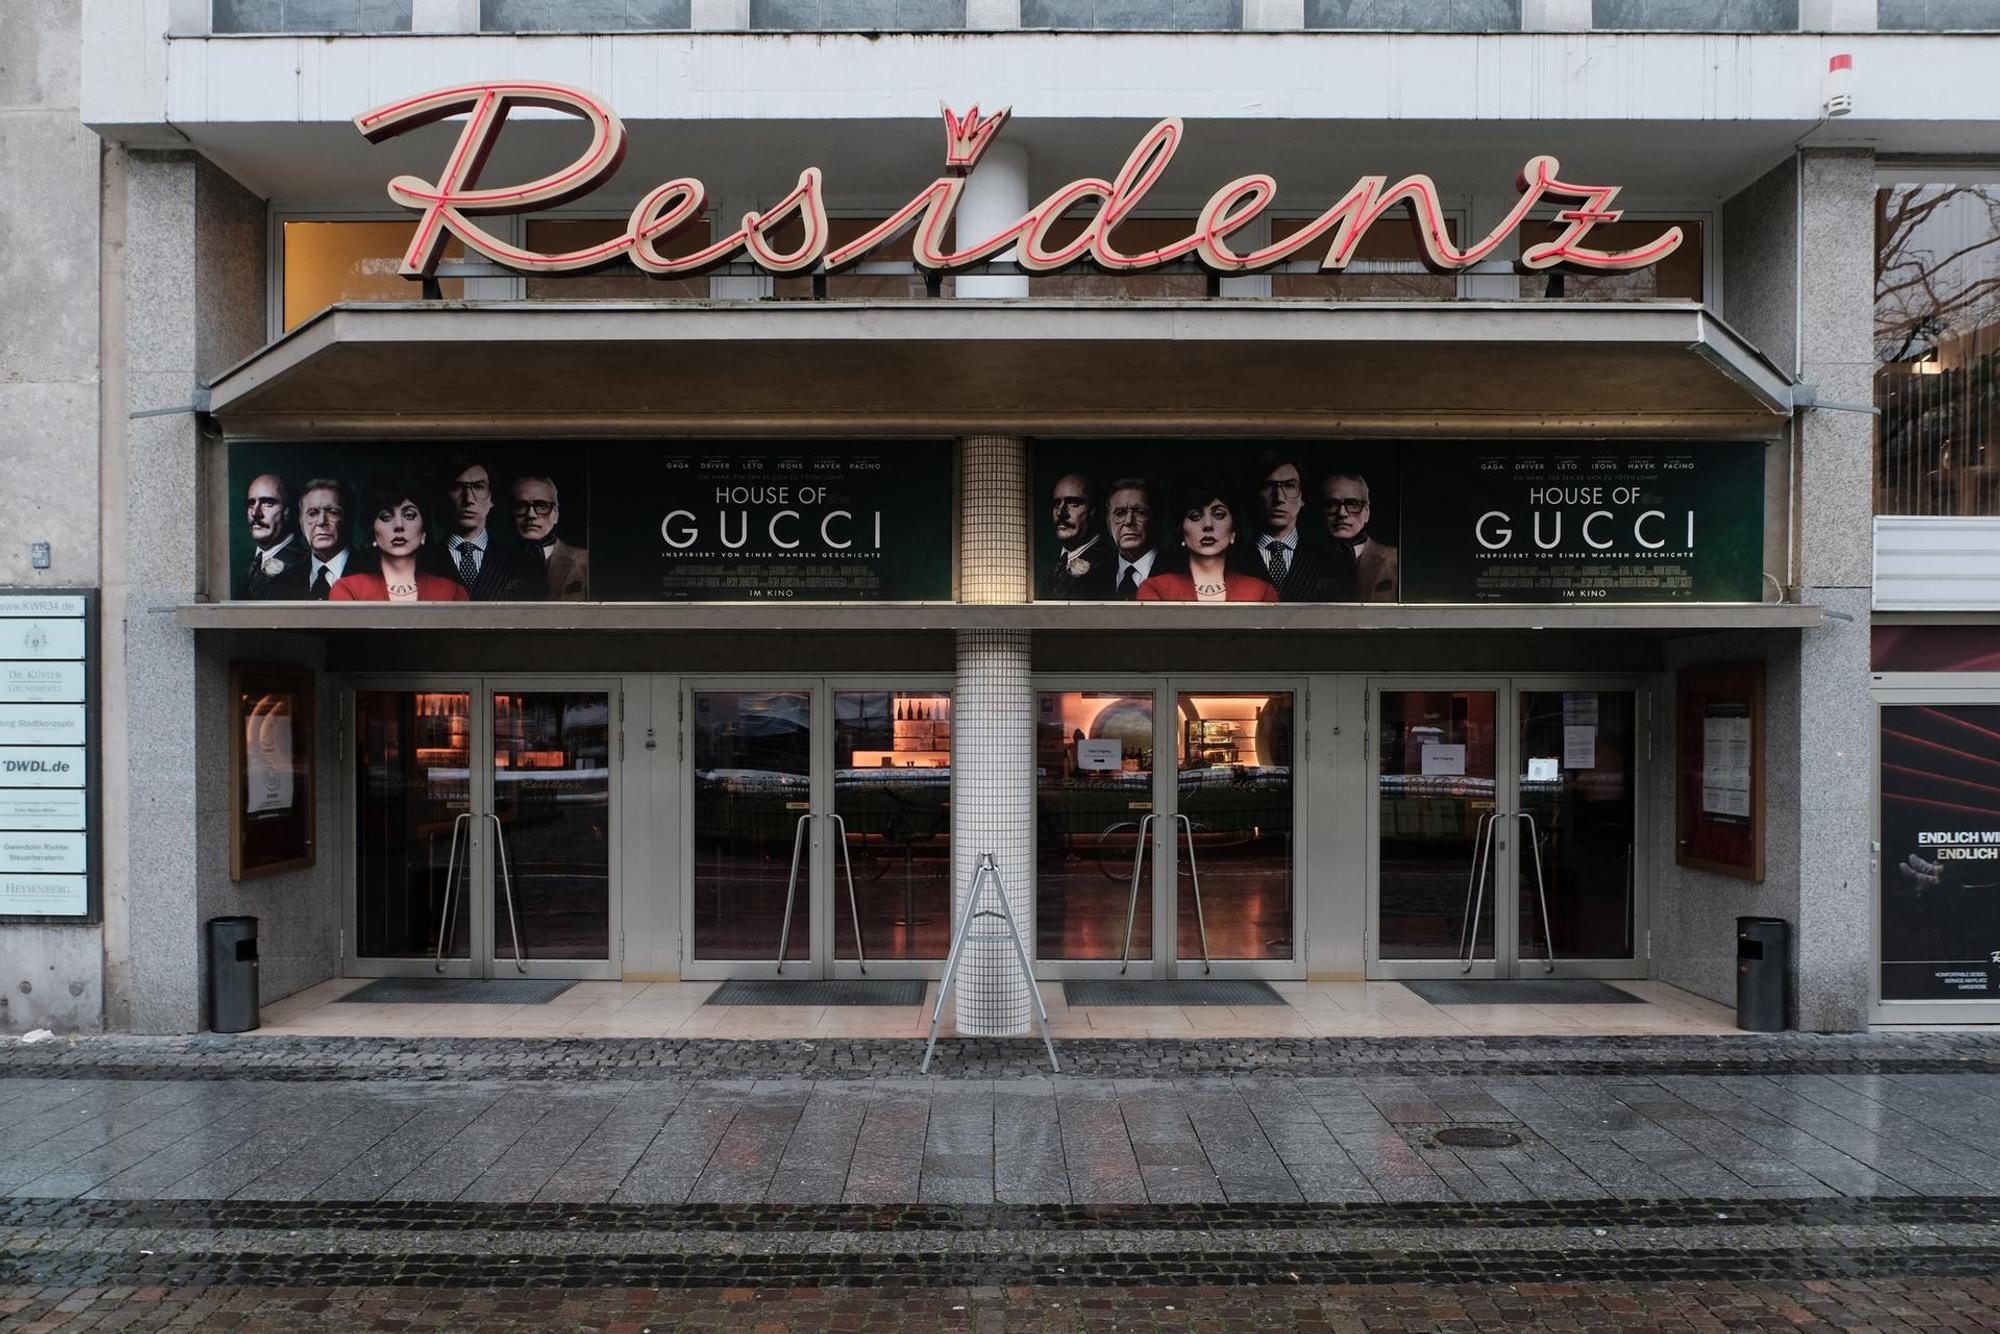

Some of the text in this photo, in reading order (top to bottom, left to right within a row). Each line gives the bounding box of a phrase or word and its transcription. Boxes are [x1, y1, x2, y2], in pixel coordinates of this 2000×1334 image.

[353, 80, 1683, 277] Residenz
[716, 487, 827, 504] HOUSE OF
[1530, 487, 1641, 505] HOUSE OF
[661, 509, 881, 549] GUCCI
[1475, 510, 1694, 550] GUCCI
[750, 589, 793, 597] IM KINO
[1563, 589, 1606, 597] IM KINO
[1918, 832, 2000, 843] ENDLICH WI
[1937, 848, 1998, 859] ENDLICH
